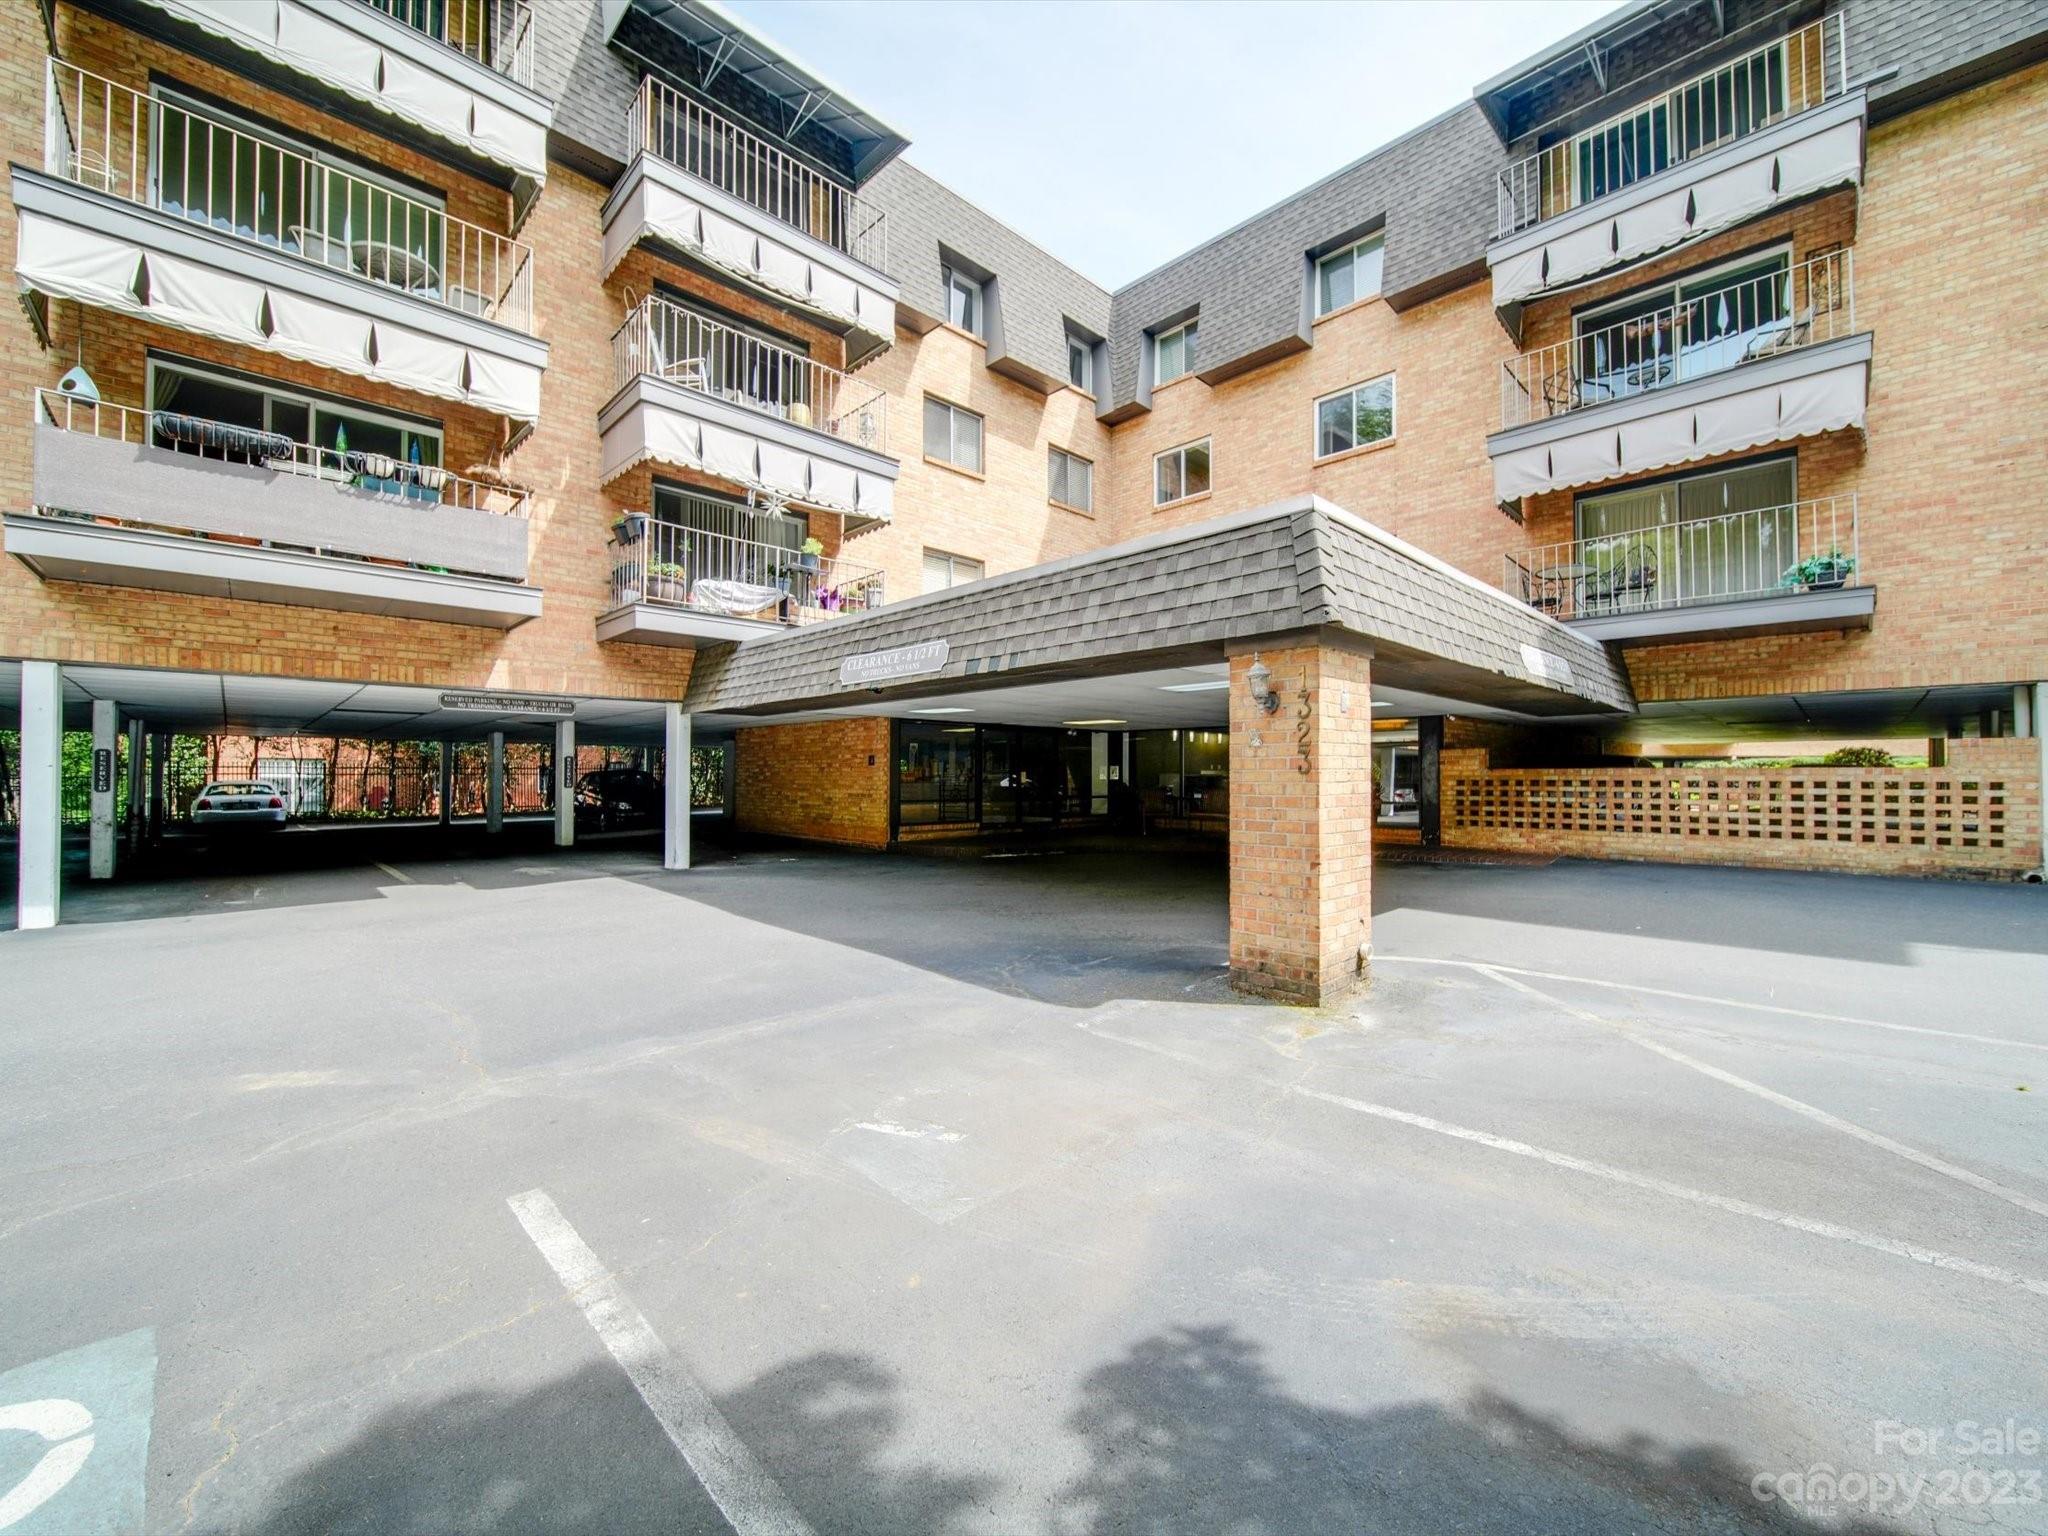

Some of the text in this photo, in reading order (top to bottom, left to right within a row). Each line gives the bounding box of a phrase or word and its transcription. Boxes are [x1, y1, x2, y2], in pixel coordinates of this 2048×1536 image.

[847, 653, 901, 671] CLEARANCE
[927, 644, 942, 658] FT
[444, 695, 473, 704] RESERVED
[474, 697, 497, 705] PARKING
[507, 704, 538, 712] CLEARANCE
[1297, 665, 1312, 775] 1323
[98, 750, 107, 791] RESERVED
